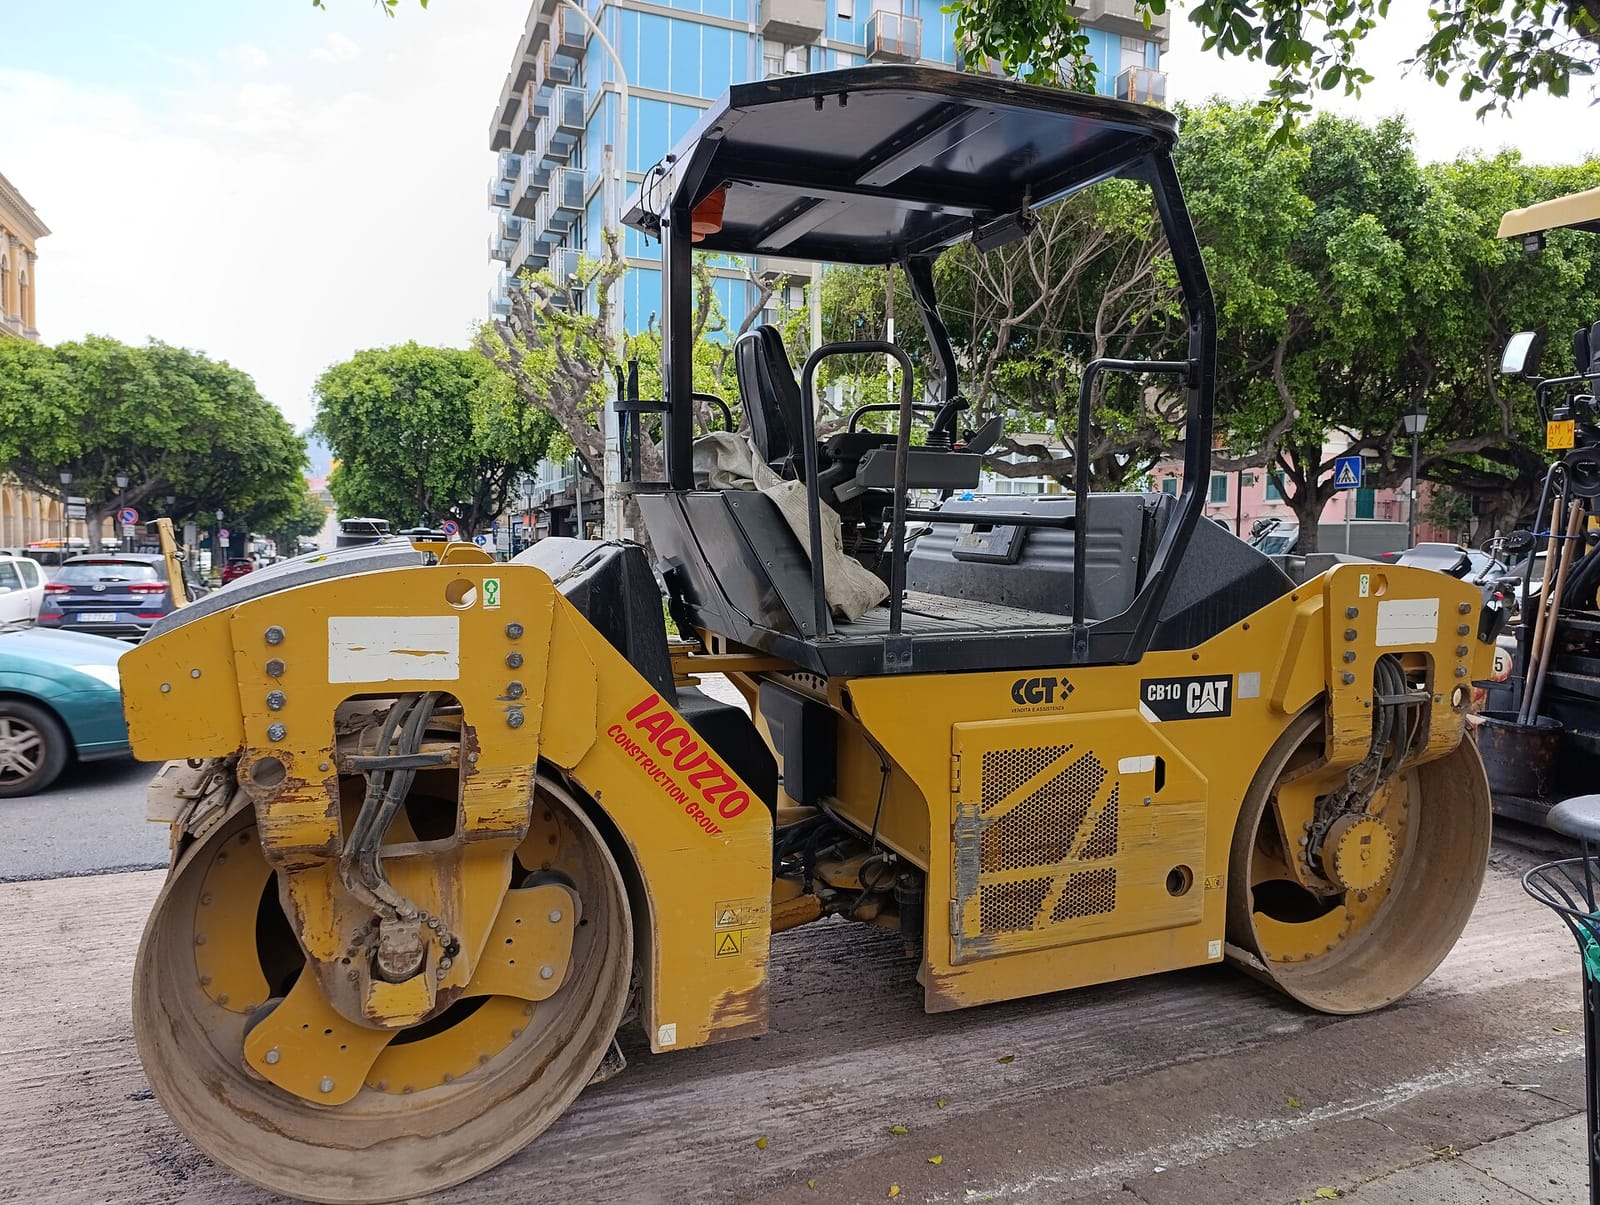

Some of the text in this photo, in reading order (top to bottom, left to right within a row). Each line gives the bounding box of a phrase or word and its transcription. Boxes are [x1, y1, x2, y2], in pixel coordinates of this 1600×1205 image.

[1011, 677, 1058, 705] CGT
[1147, 681, 1228, 714] CB10 CAT
[607, 724, 689, 805] CONSTRUCTION
[625, 693, 750, 819] IACUZZO
